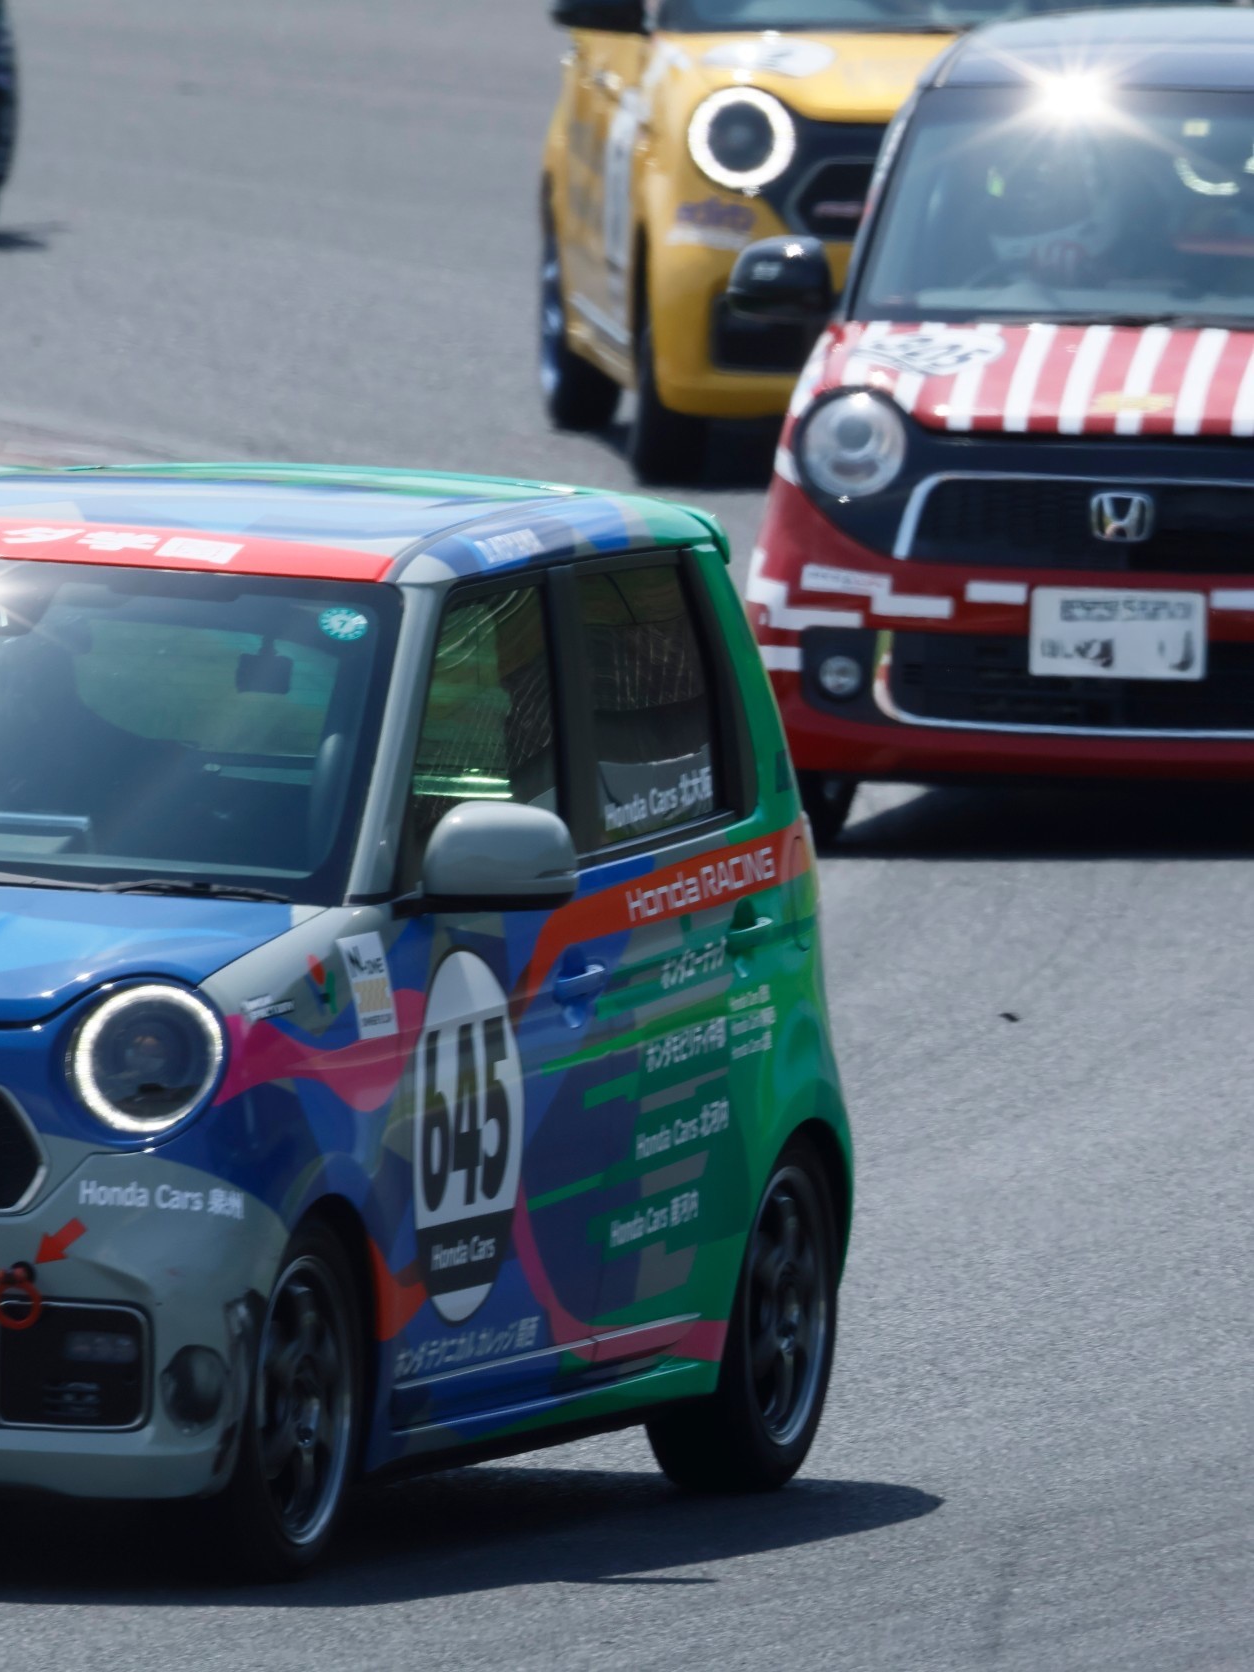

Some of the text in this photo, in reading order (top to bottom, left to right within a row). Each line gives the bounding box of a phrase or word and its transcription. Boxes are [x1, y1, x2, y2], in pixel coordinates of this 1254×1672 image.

[649, 787, 678, 815] Cars
[626, 847, 775, 921] Honda RACING
[422, 1015, 511, 1213] 645
[672, 1118, 699, 1147] Cars
[79, 1180, 149, 1208] Honda
[155, 1184, 203, 1211] Cars
[431, 1234, 496, 1272] Honda Cars
